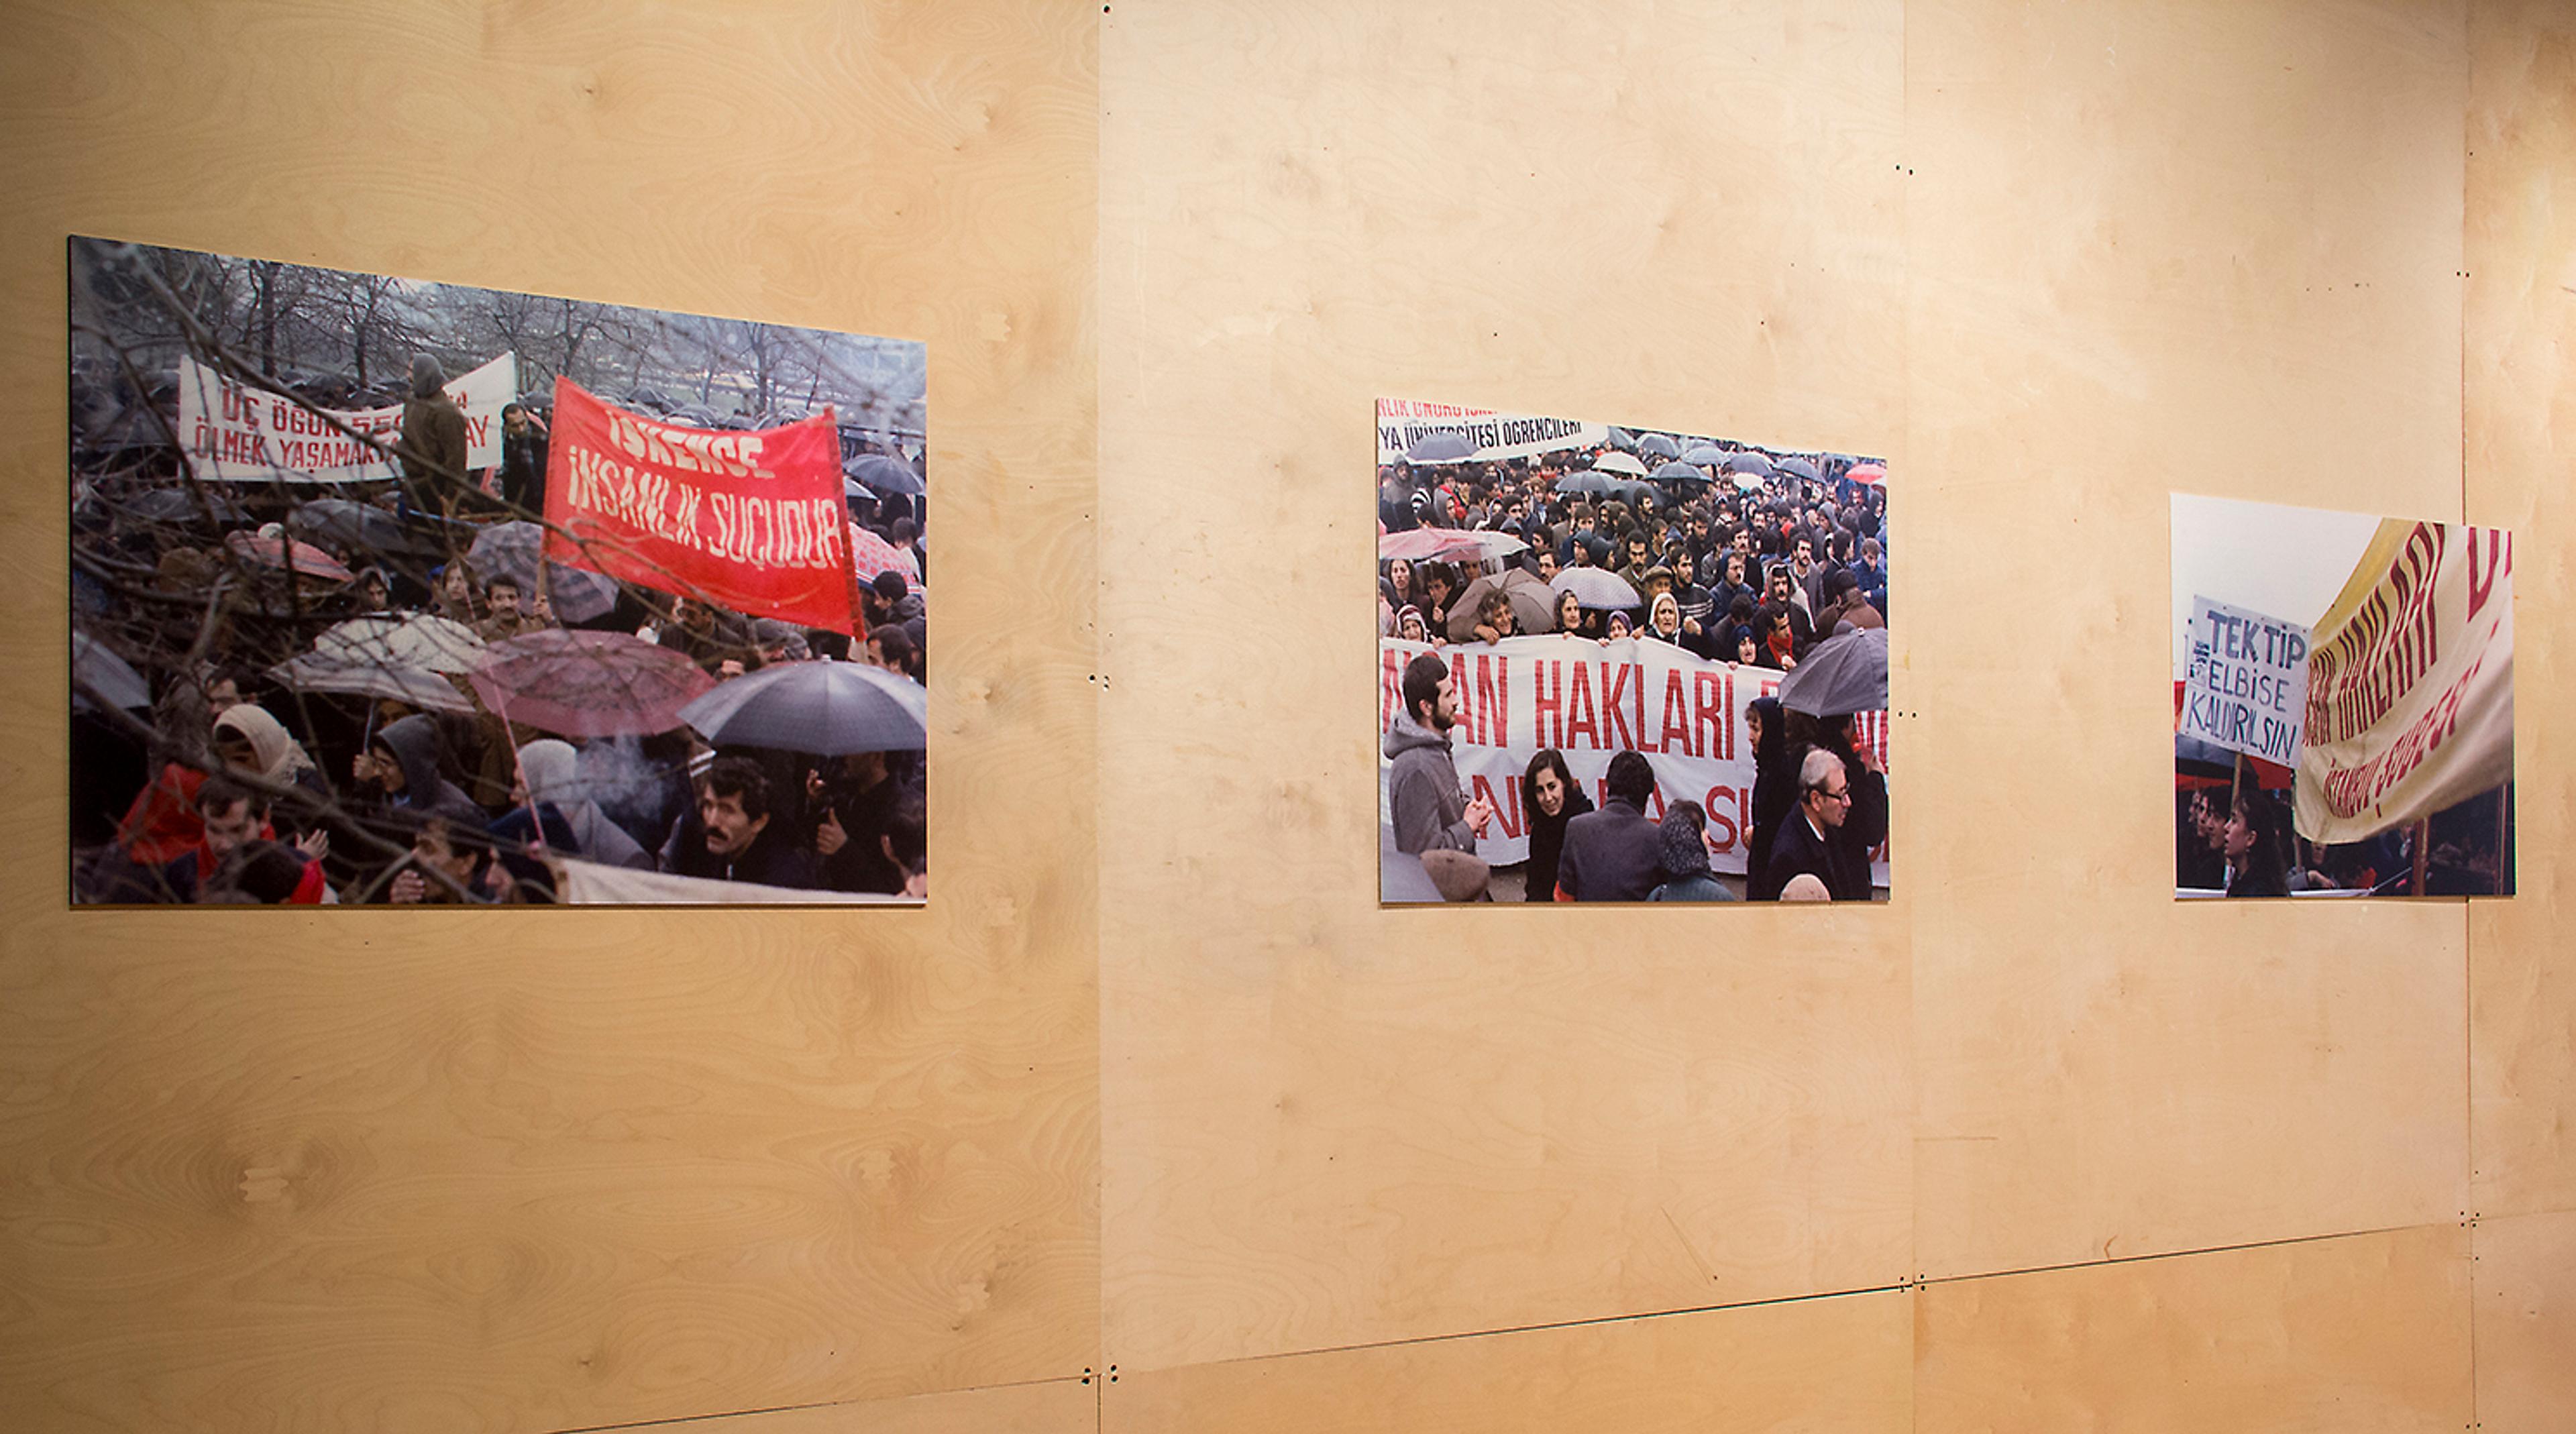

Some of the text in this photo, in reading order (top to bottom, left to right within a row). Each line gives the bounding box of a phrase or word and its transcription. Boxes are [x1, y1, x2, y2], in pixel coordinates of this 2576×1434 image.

[195, 416, 267, 466] ÖLMEK
[1379, 427, 1403, 451] YA
[568, 445, 845, 571] İNSANLIK SUÇUDUR
[2207, 610, 2260, 663] TEK
[2263, 624, 2306, 669] TİP
[1383, 649, 1734, 761] NAN HAKLARI
[2208, 659, 2290, 712] ELBİSE
